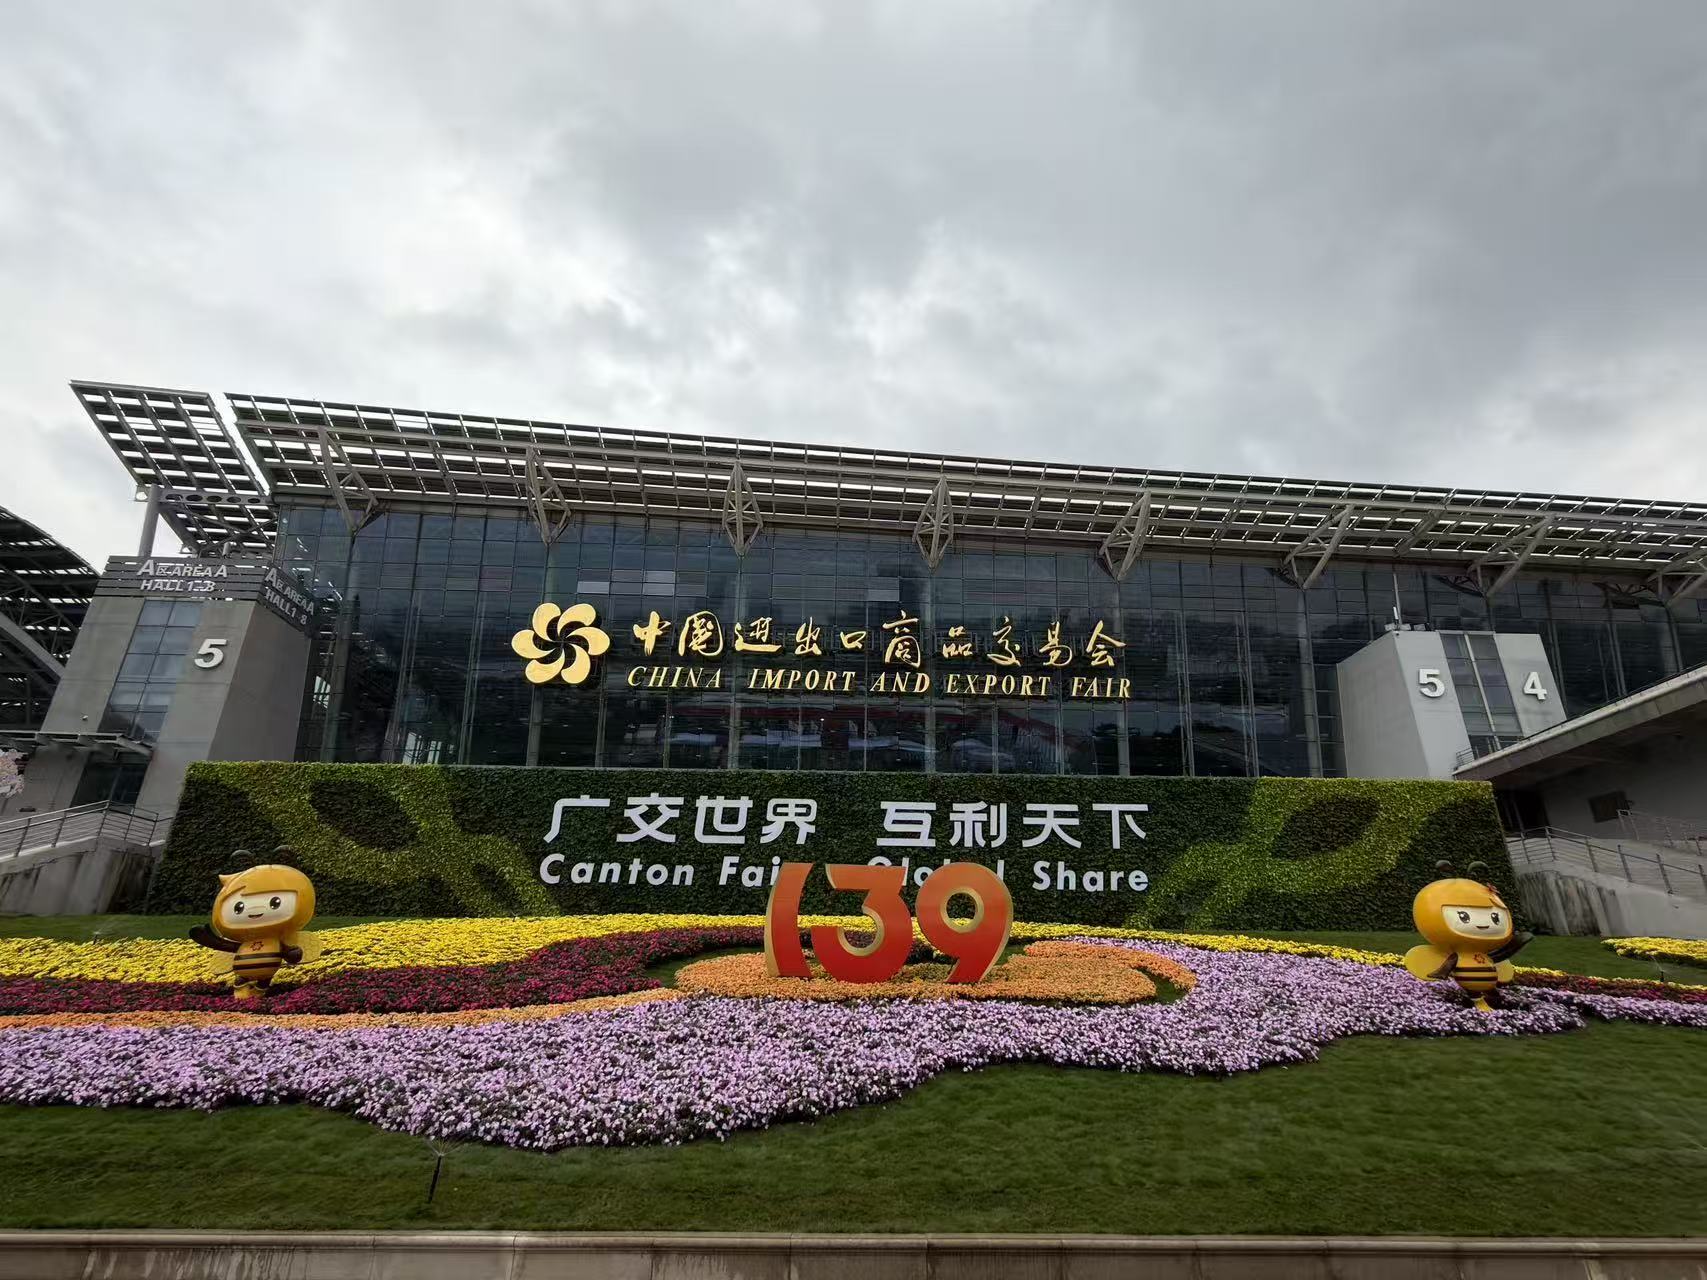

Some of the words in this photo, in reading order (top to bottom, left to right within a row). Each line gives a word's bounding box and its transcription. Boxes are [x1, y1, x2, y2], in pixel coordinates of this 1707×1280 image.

[140, 579, 184, 591] HALL
[170, 565, 213, 577] AREA
[265, 588, 291, 615] HALL
[194, 638, 228, 669] 5
[627, 666, 722, 689] CHINA
[748, 668, 856, 692] IMPORT
[870, 671, 930, 694] AND
[946, 674, 1051, 697] EXPORT
[1071, 676, 1132, 699] FAIR
[1418, 668, 1445, 698] 5
[1523, 671, 1547, 701] 4
[543, 792, 818, 845] 广交世界
[876, 800, 1149, 849] 互利天下
[539, 853, 695, 886] Canton
[718, 855, 783, 888] Fai
[1032, 860, 1149, 892] Share
[763, 862, 1014, 984] 139
